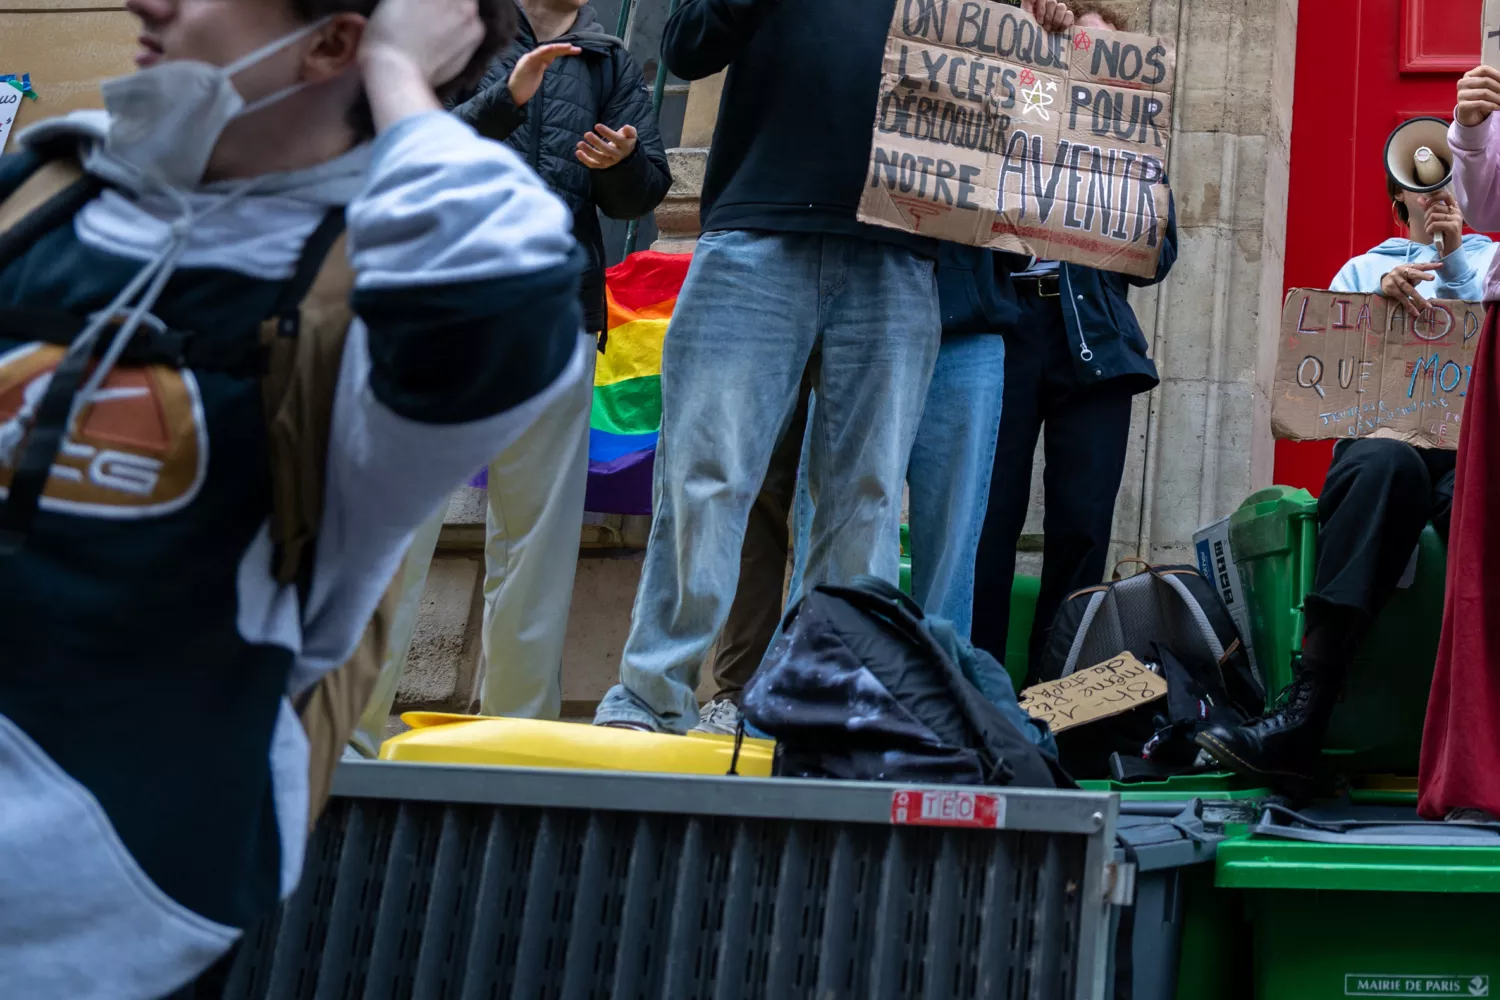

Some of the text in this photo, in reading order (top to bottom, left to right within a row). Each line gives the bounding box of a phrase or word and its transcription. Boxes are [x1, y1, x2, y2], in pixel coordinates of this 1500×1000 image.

[956, 1, 1073, 70] BLOQUE
[1090, 37, 1167, 85] NOS
[899, 45, 1163, 147] LYCÉES POUR
[871, 129, 1164, 248] NOTRE AVENIR
[1296, 354, 1374, 399] QUE
[1357, 979, 1461, 992] MAIRIE DE PARIS
